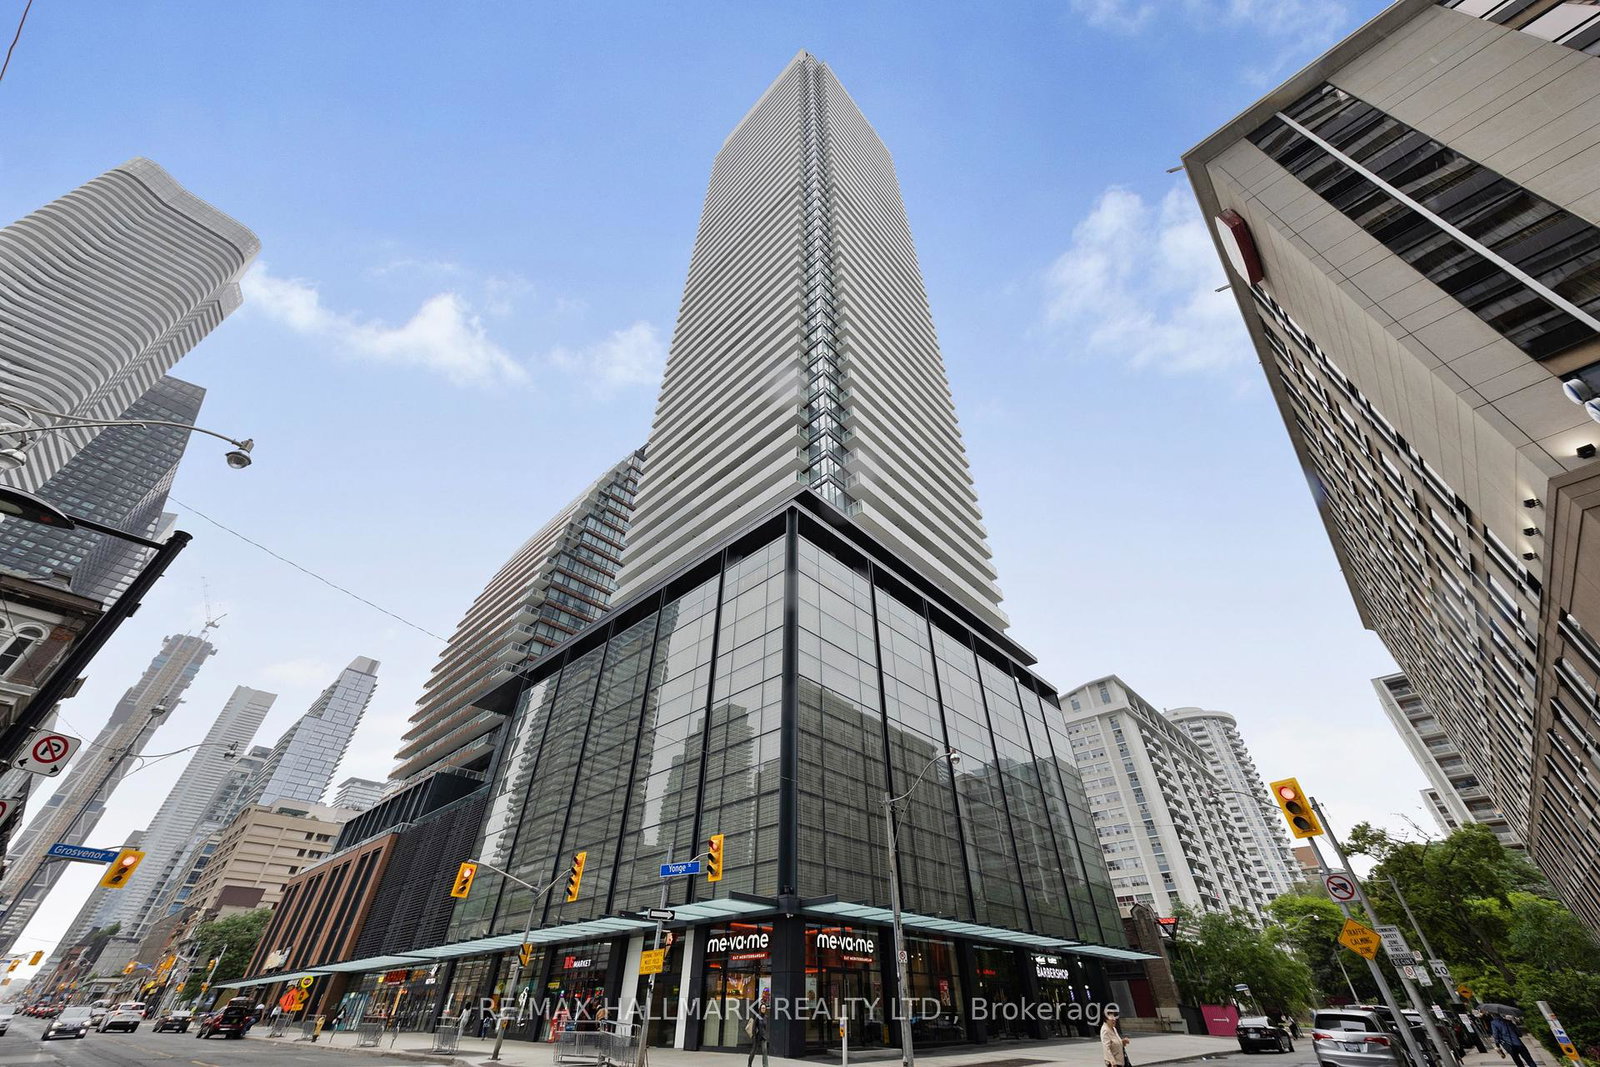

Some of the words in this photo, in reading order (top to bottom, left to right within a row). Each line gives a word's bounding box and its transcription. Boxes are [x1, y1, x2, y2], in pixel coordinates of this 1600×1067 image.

[54, 845, 106, 859] Grosvenor
[668, 864, 687, 874] Yonge
[1345, 927, 1368, 936] TRAFFIC
[1349, 936, 1373, 946] CALMING
[573, 959, 592, 968] MARKET
[1036, 965, 1069, 980] BARBERSHOP
[1434, 966, 1448, 975] 40
